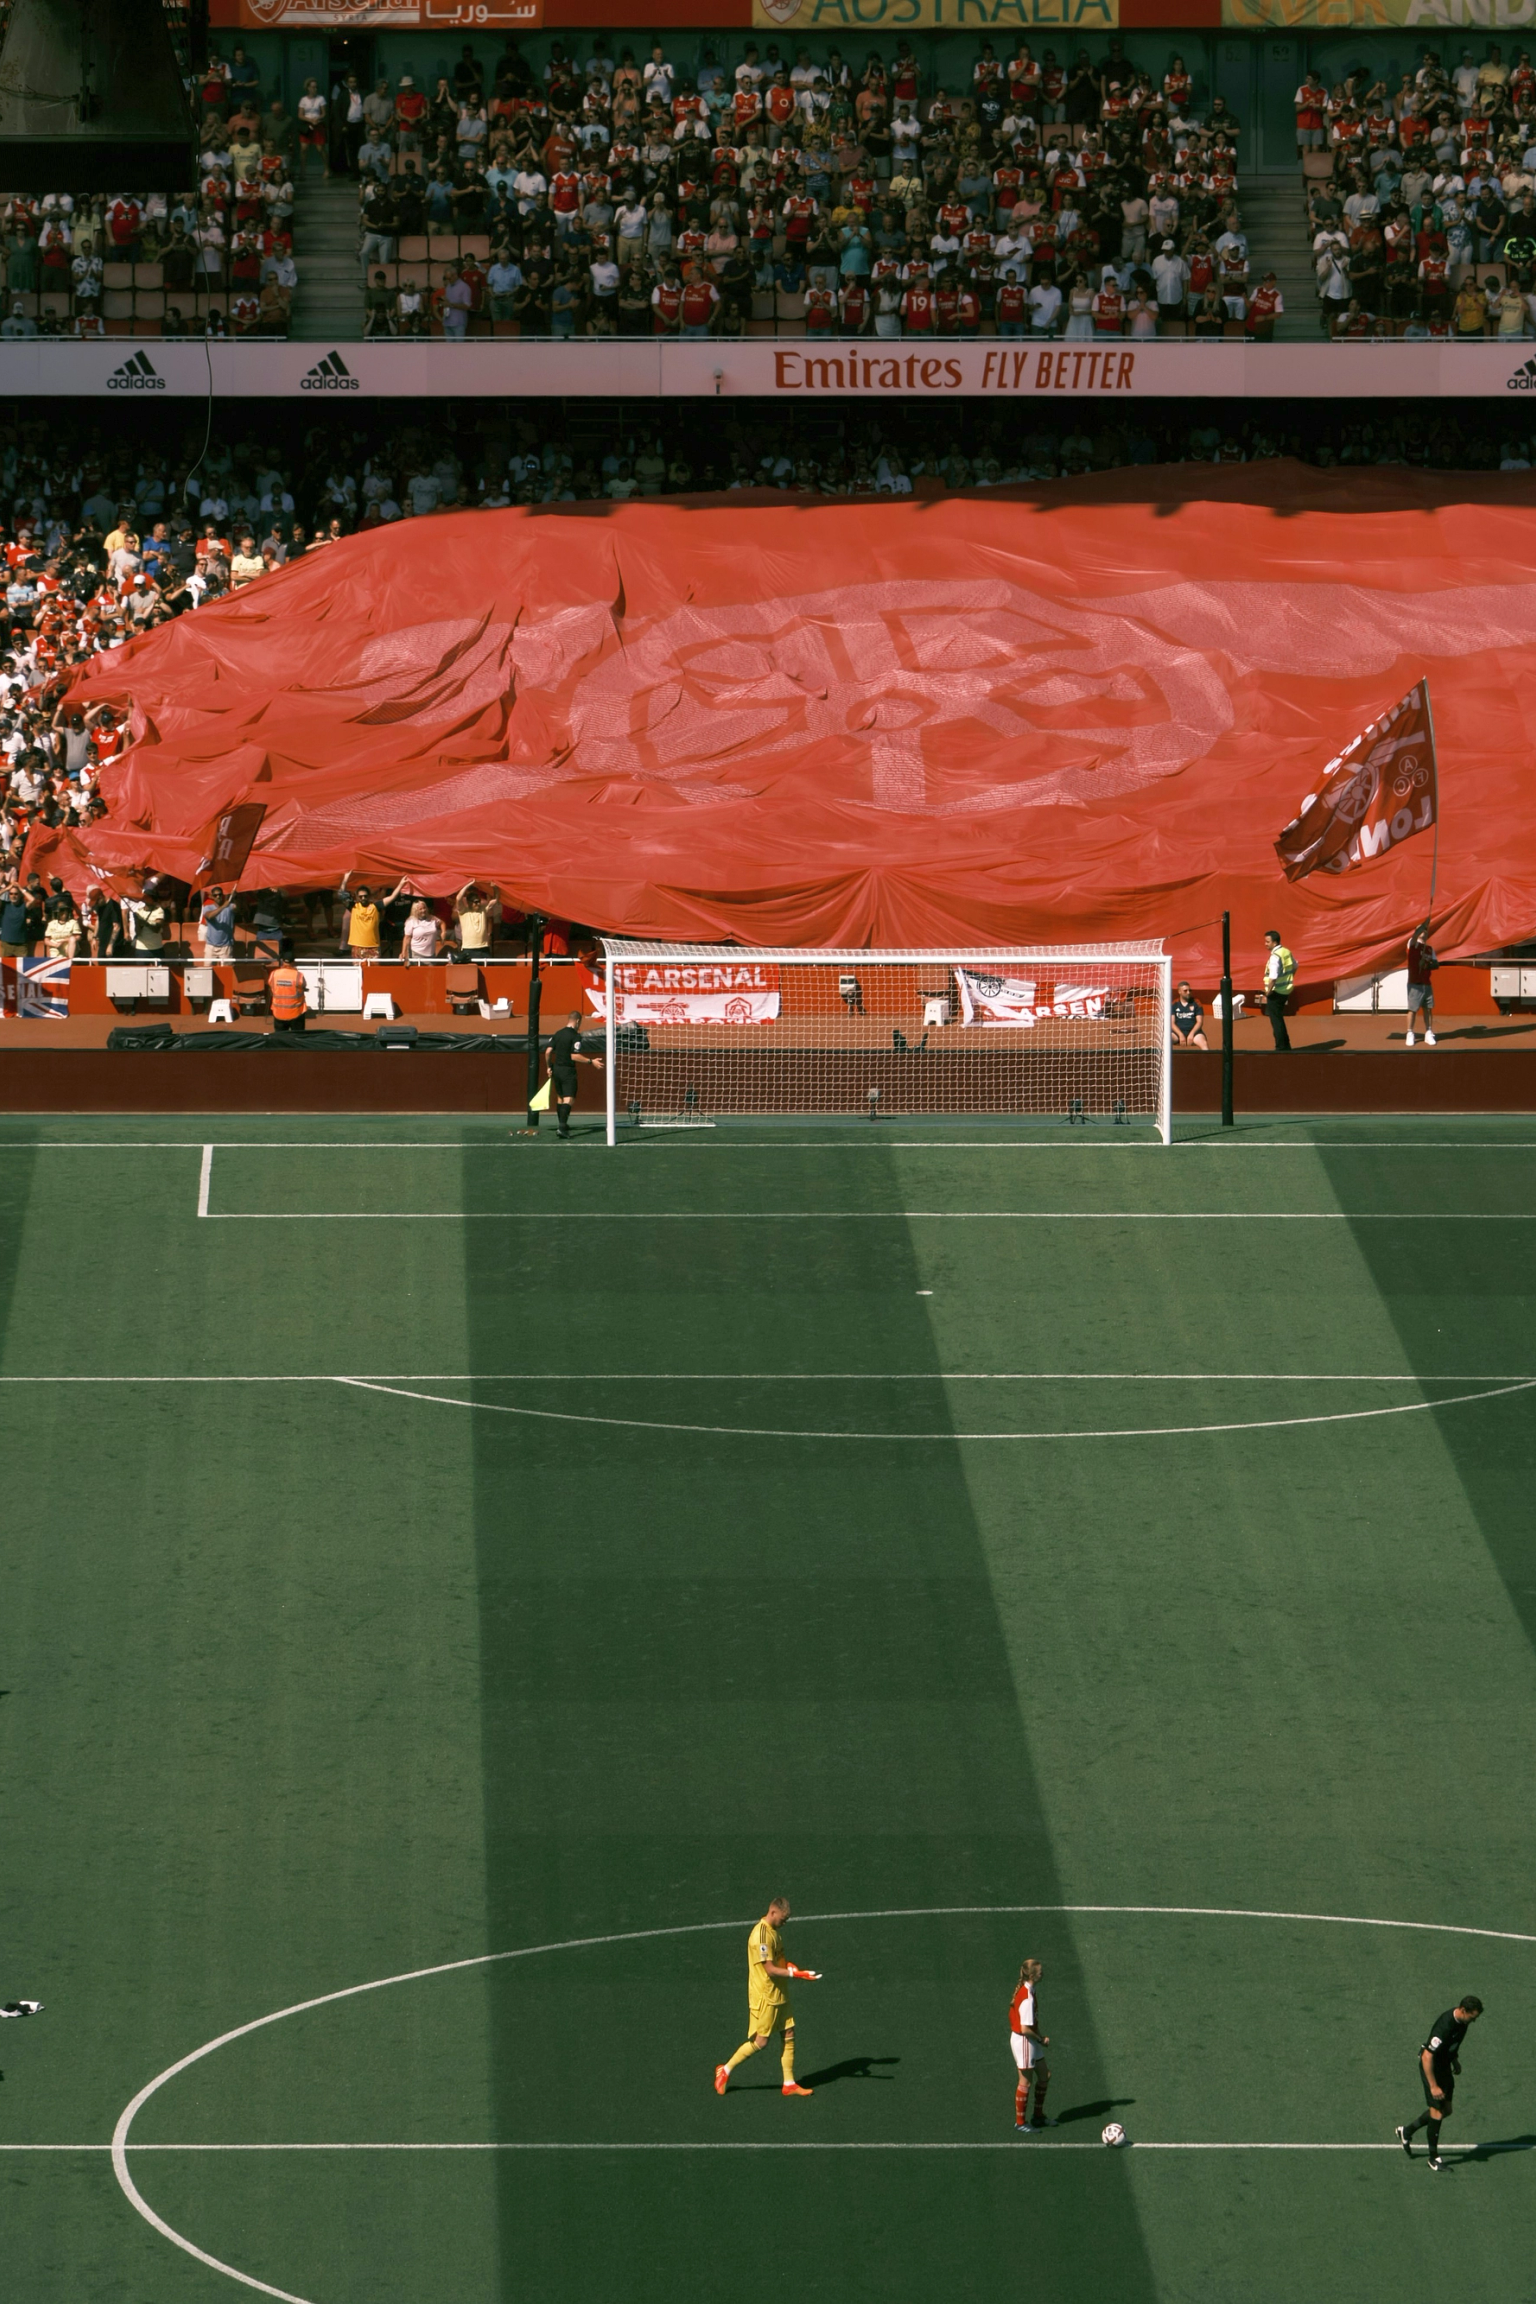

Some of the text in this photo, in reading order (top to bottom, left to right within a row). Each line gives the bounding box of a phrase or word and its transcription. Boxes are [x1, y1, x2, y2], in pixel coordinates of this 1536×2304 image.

[332, 13, 368, 22] SYRIA
[911, 296, 927, 312] 19
[774, 349, 1135, 389] Emirates FLY BETTER
[106, 374, 166, 390] adidas
[300, 374, 360, 390] adidas
[643, 966, 767, 989] ARSENAL
